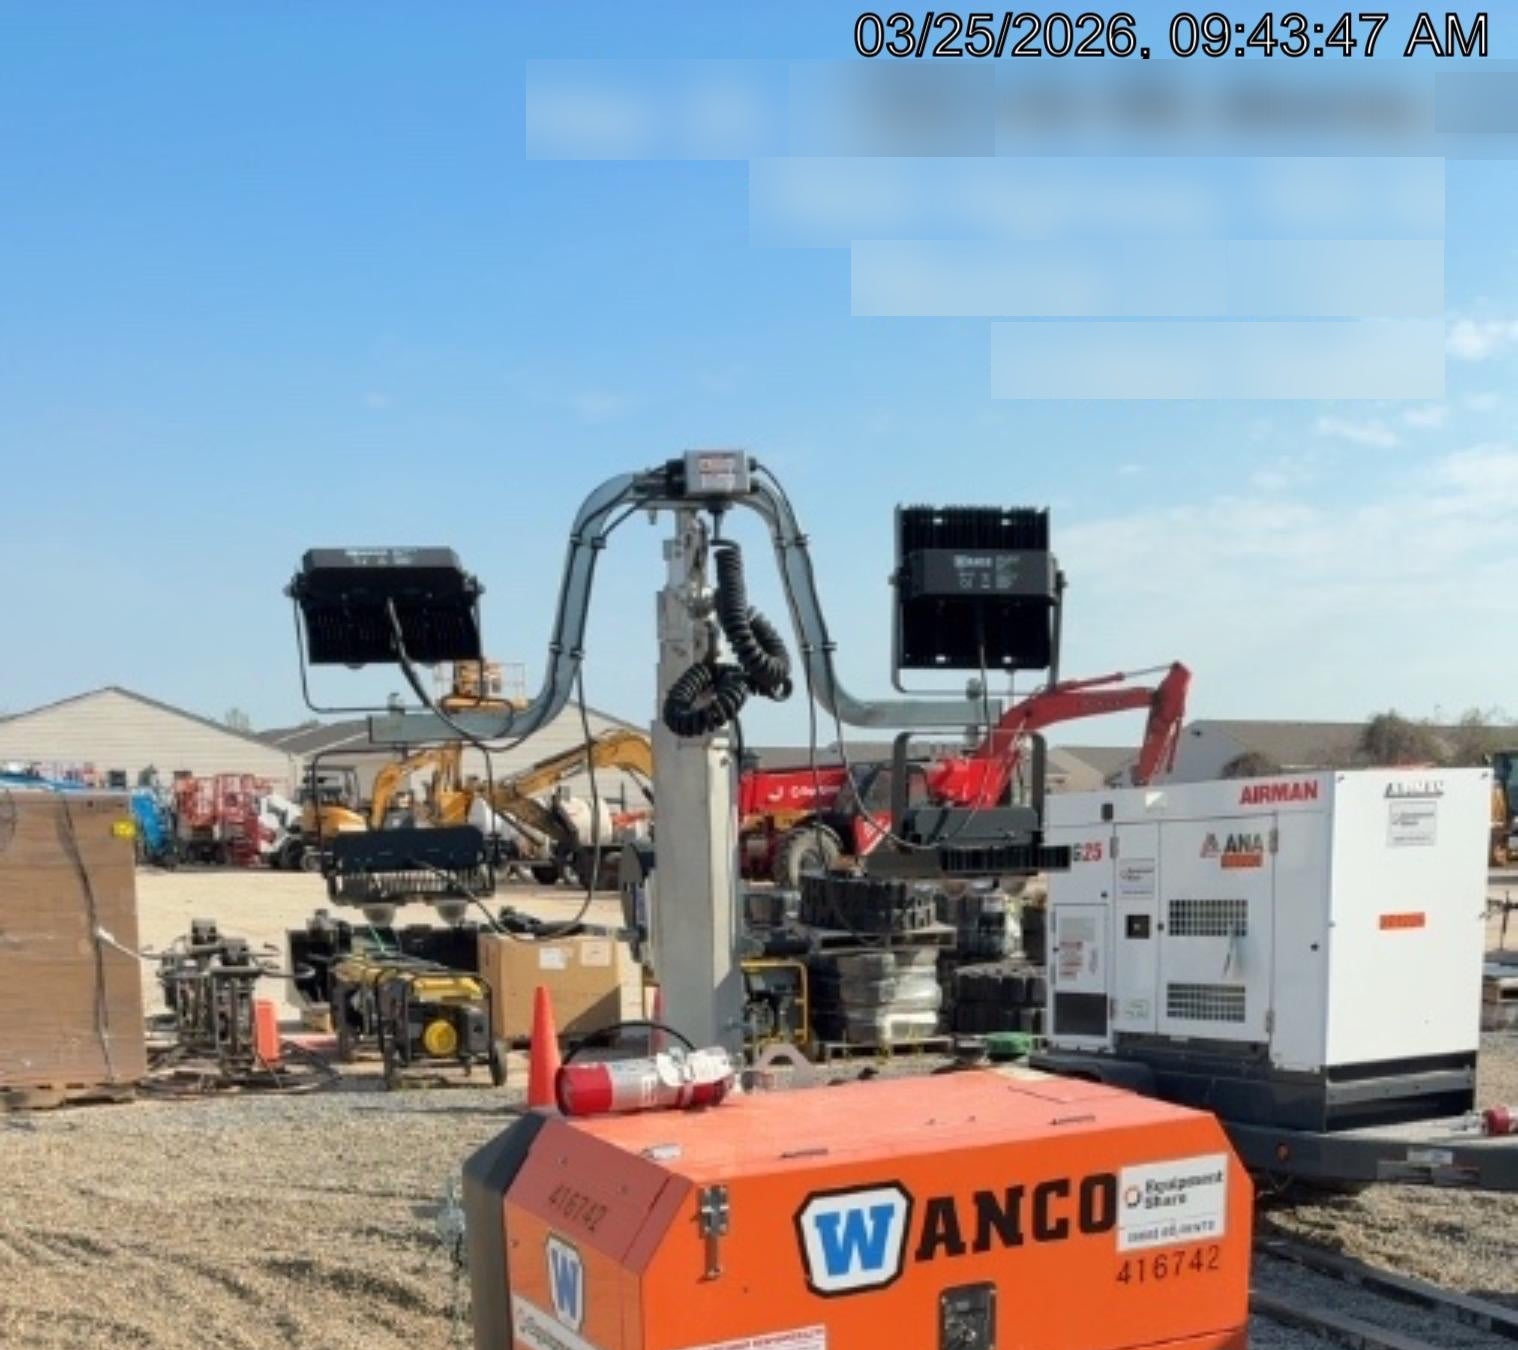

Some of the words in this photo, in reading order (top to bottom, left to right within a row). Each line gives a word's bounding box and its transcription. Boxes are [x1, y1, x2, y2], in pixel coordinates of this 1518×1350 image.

[1239, 780, 1318, 804] AIRMAN
[1145, 1170, 1223, 1194] Equipment
[1145, 1193, 1187, 1210] Share
[1116, 1245, 1220, 1284] 416742
